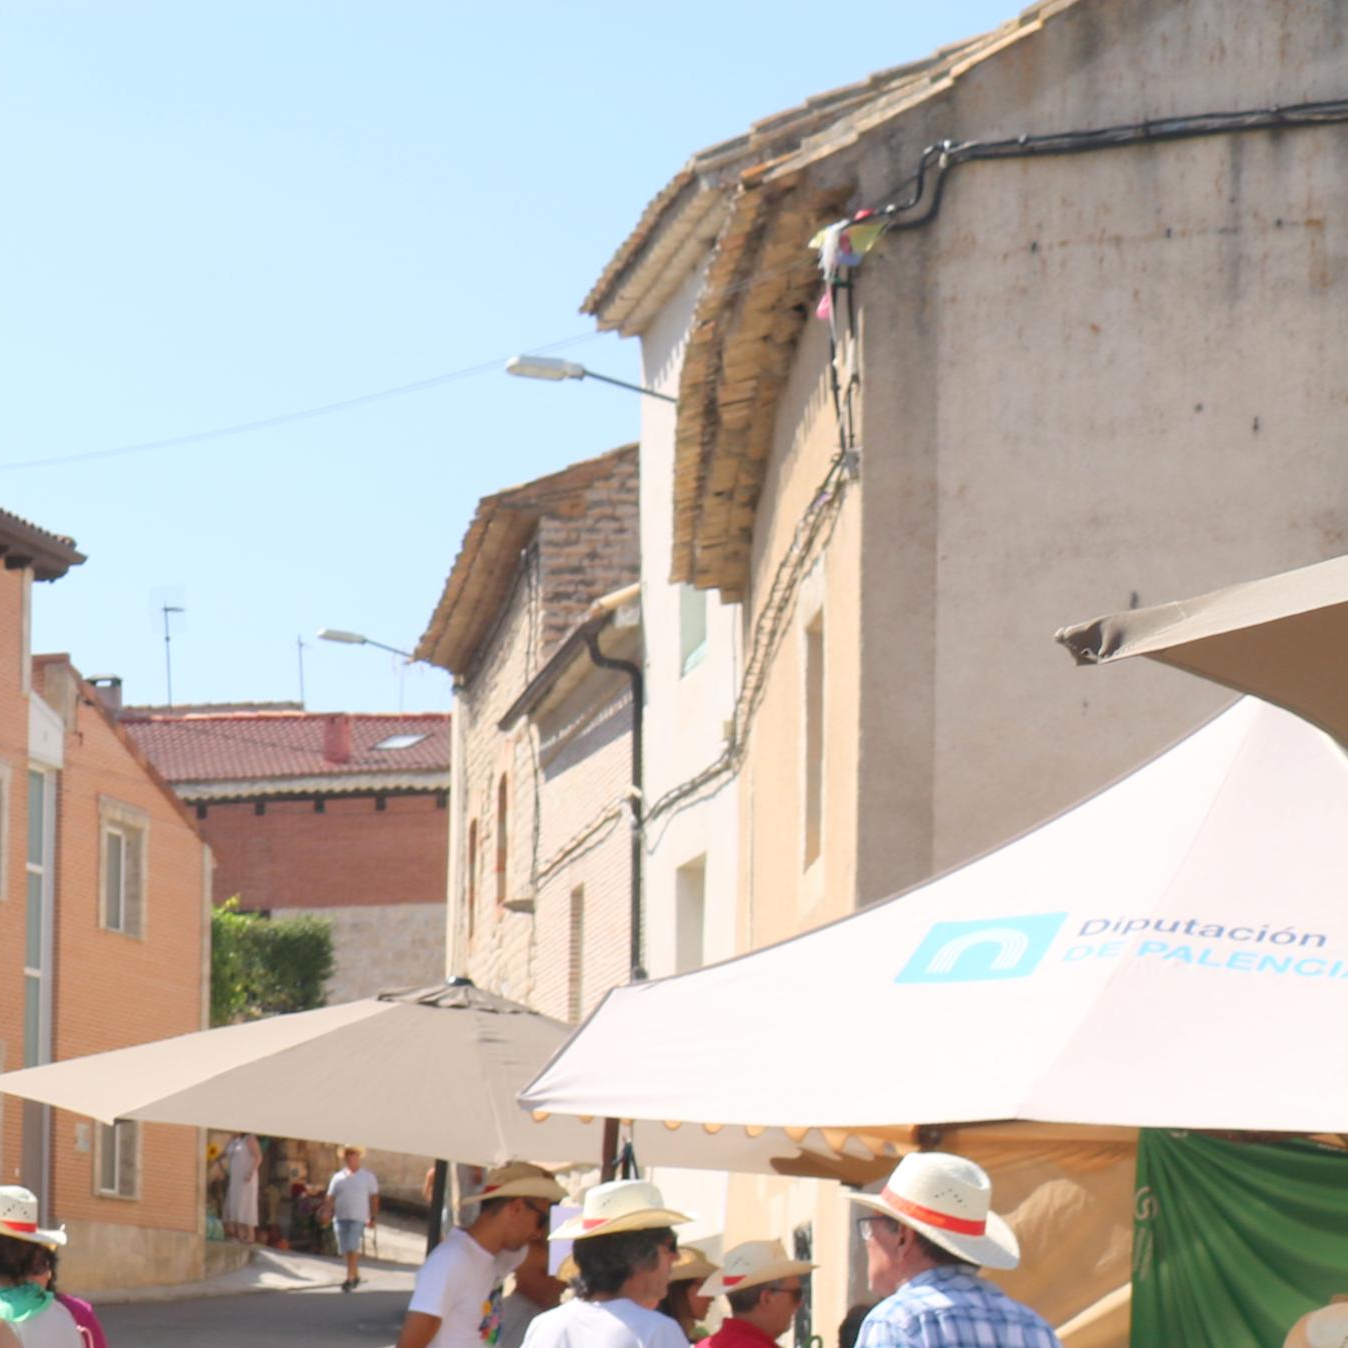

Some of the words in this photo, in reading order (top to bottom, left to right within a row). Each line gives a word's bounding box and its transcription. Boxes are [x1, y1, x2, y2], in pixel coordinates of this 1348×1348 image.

[1078, 916, 1328, 947] Diputación
[1062, 940, 1126, 962] DE
[1136, 940, 1348, 979] PALENCI
